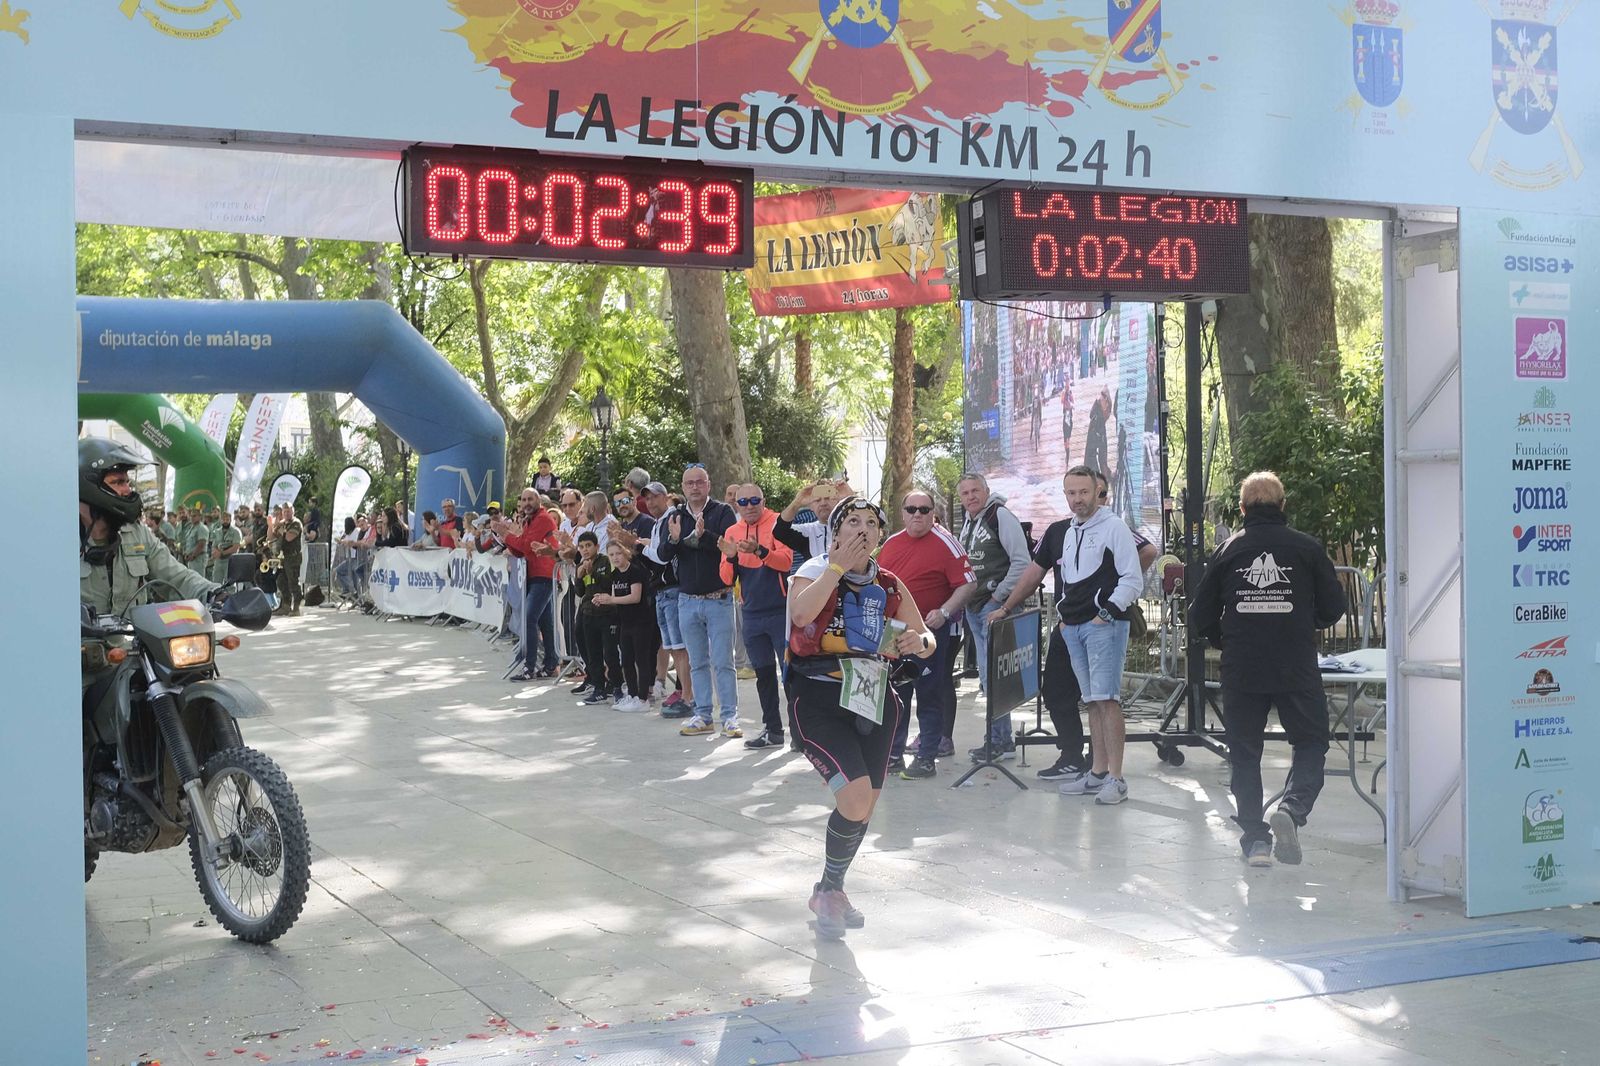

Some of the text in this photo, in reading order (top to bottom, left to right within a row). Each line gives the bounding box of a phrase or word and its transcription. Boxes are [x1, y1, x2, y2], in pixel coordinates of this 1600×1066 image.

[545, 89, 1151, 186] LA LEGIÓN 101 KM 24 h
[427, 166, 738, 255] 00:02:39
[1013, 192, 1238, 225] LA LEGION
[767, 218, 883, 273] LA LEGIÓN
[1032, 233, 1198, 280] 0:02:40
[1504, 255, 1558, 273] asisa
[841, 291, 855, 304] 24
[857, 288, 889, 303] horas
[99, 329, 272, 350] diputación de málaga
[142, 420, 173, 446] Fundación
[1515, 442, 1568, 456] Fundación
[1512, 459, 1571, 471] MAPFRE
[1538, 524, 1572, 538] INTER
[1537, 538, 1572, 552] SPORT
[408, 570, 433, 587] asisa
[1535, 570, 1570, 586] TRC
[1515, 604, 1567, 622] CeraBike
[1515, 649, 1568, 659] ALTRA
[1531, 717, 1565, 726] HIERROS
[1531, 726, 1573, 736] VÉLEZ S.A.
